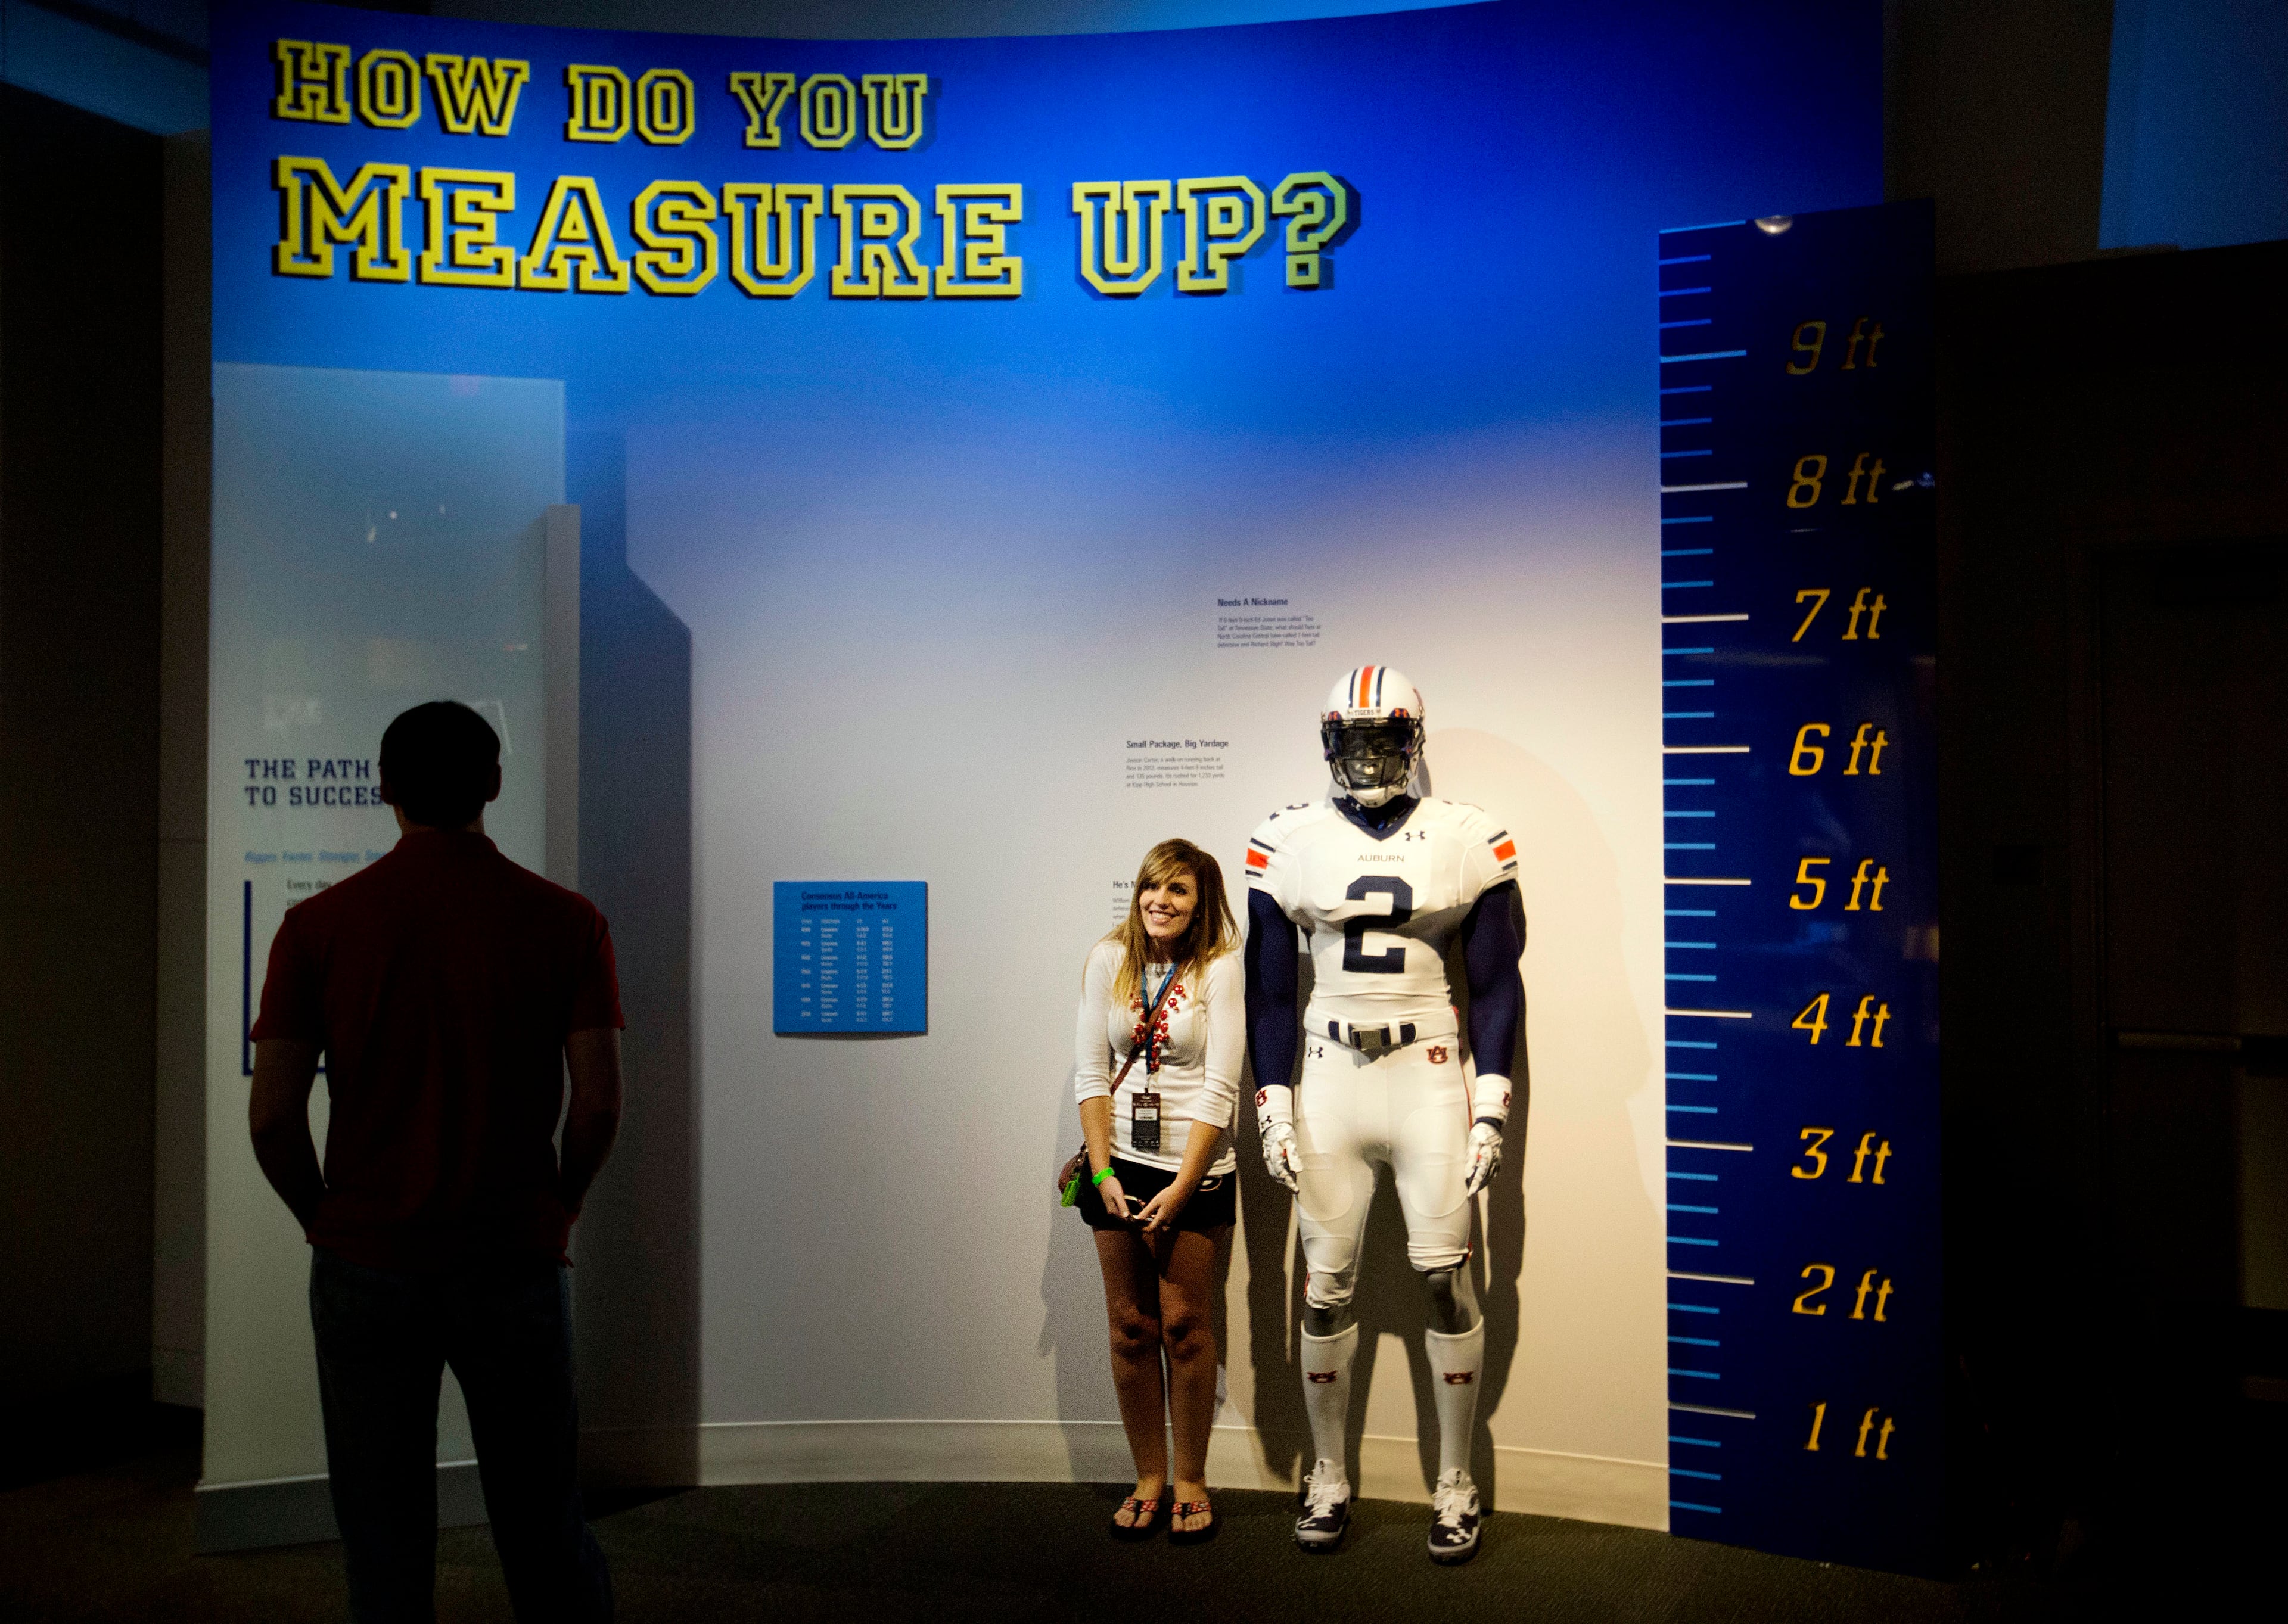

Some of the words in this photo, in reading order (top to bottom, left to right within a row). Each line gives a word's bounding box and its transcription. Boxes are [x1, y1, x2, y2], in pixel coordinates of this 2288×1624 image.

[275, 38, 530, 136] HOW
[566, 63, 695, 145] DO
[729, 72, 928, 149] YOU
[275, 155, 1023, 298] MEASURE
[1071, 170, 1348, 295] UP?
[1786, 320, 1826, 375] 9
[1841, 316, 1885, 370] ft
[1786, 454, 1828, 508] 8
[1841, 452, 1886, 505] ft
[1792, 588, 1830, 643] 7
[1842, 587, 1887, 640] ft
[244, 758, 296, 779] THE
[307, 758, 370, 779] PATH
[1126, 740, 1146, 748] Small
[1185, 739, 1197, 749] Big
[1199, 739, 1229, 749] Yardage
[1788, 722, 1830, 776] 6
[1842, 722, 1888, 776] ft
[244, 786, 276, 806] TO
[1112, 881, 1129, 889] He's
[1789, 857, 1831, 910] 5
[1844, 858, 1889, 911] ft
[1342, 875, 1413, 974] 2
[1791, 993, 1830, 1045] 4
[1845, 994, 1891, 1048] ft
[1790, 1127, 1835, 1180] 3
[1846, 1131, 1892, 1185] ft
[1792, 1262, 1835, 1316] 2
[1848, 1267, 1894, 1322] ft
[1803, 1400, 1827, 1452] 1
[1854, 1406, 1895, 1460] ft
